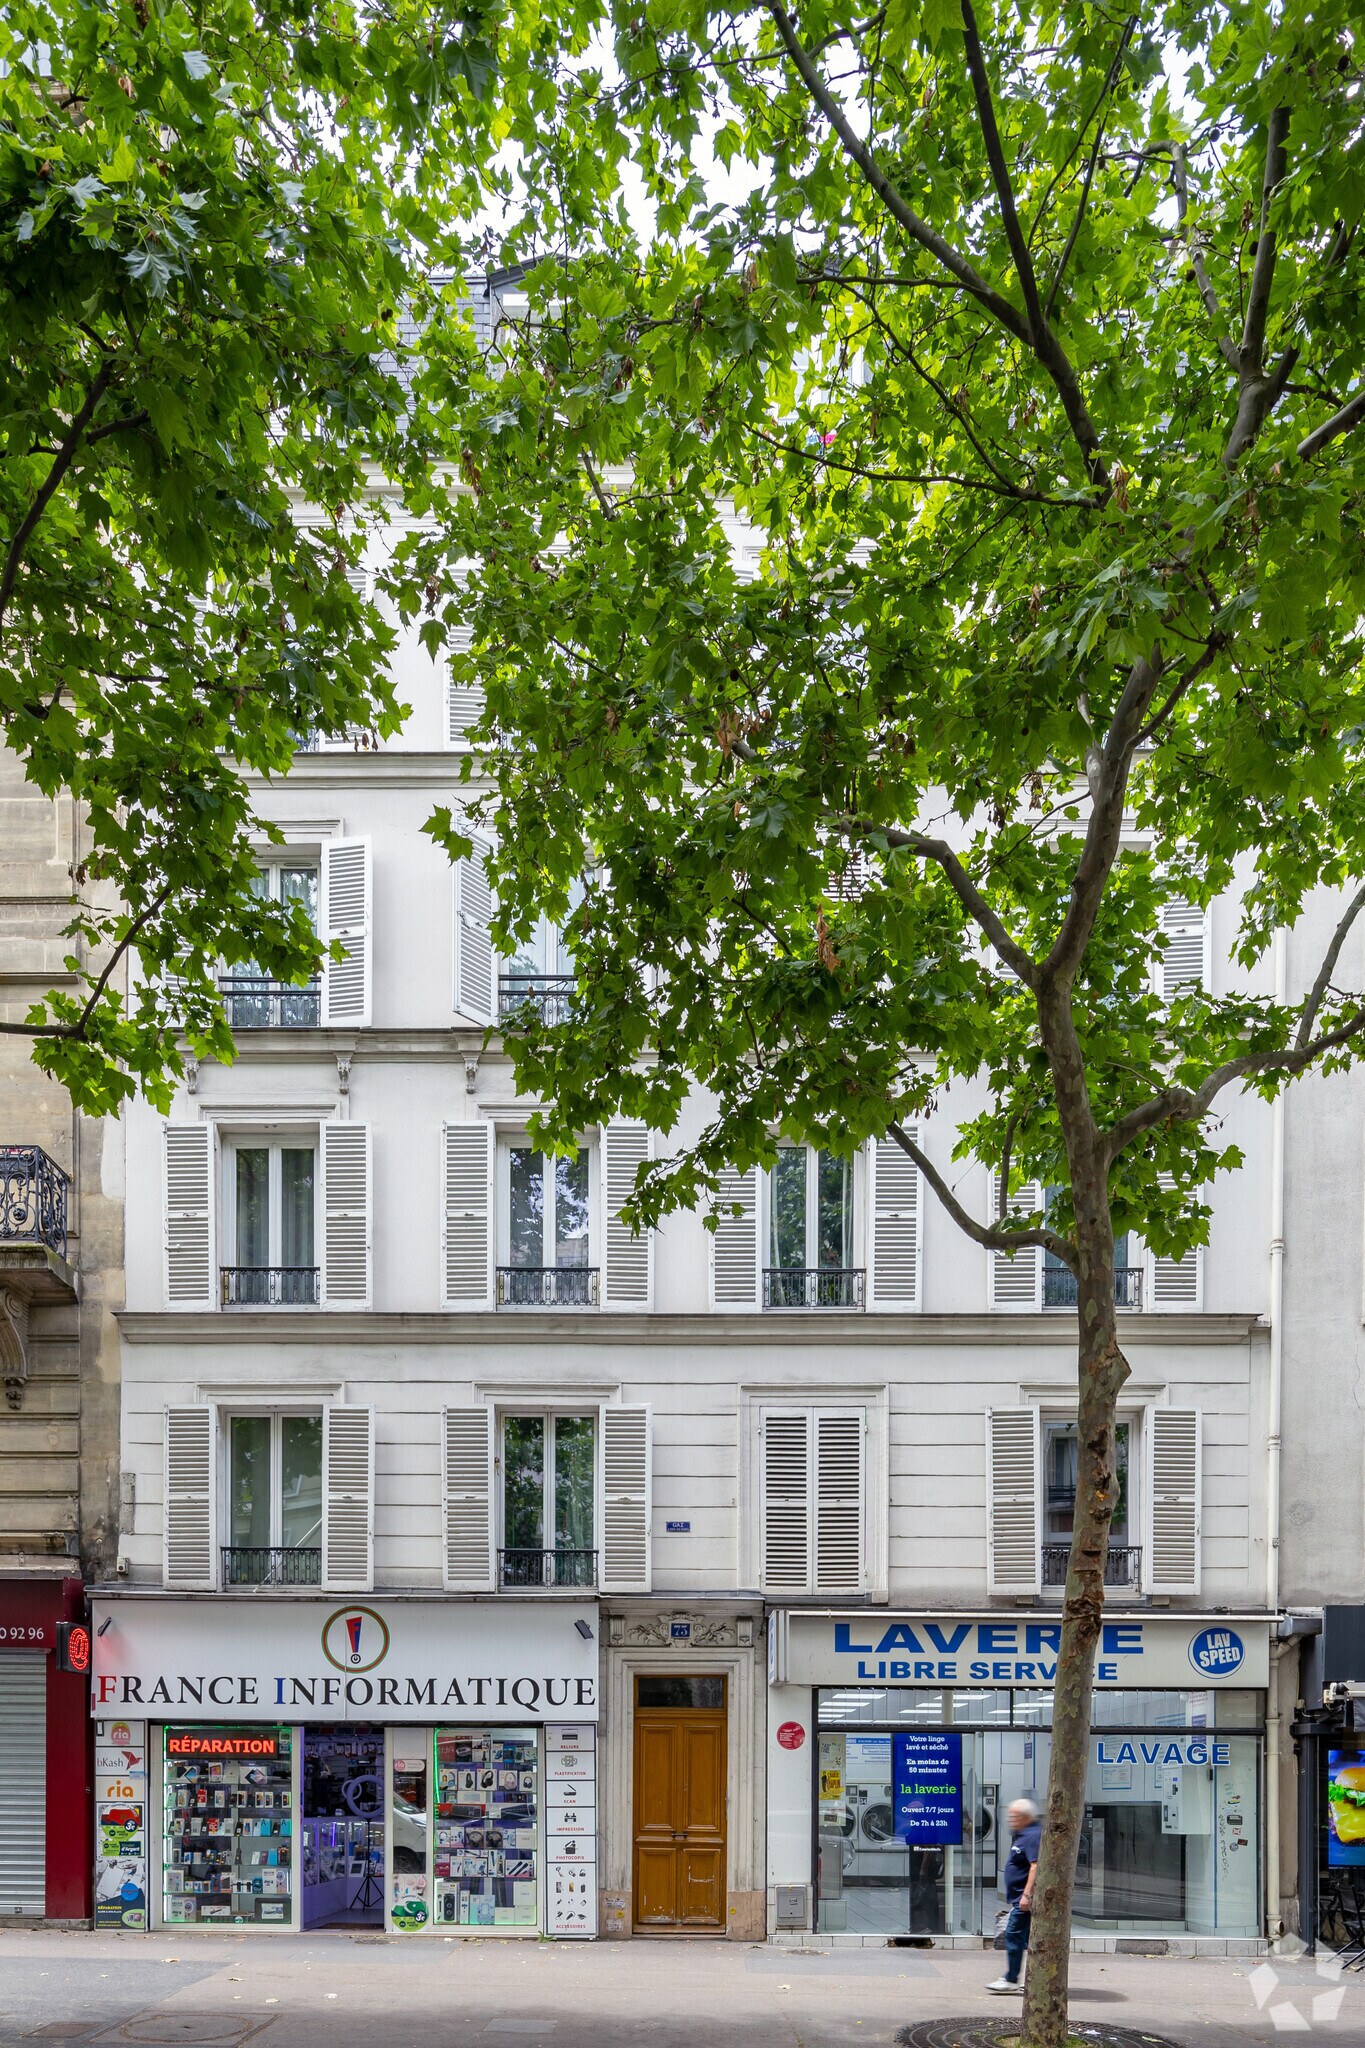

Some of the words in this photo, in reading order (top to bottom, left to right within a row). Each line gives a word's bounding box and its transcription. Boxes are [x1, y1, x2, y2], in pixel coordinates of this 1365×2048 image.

[10, 1627, 25, 1640] 92
[28, 1627, 44, 1640] 96
[674, 1625, 688, 1636] 73
[835, 1624, 1143, 1654] LAVERE
[1206, 1633, 1230, 1650] LAV
[1199, 1647, 1240, 1667] SPEED
[858, 1661, 957, 1679] LIBRE
[969, 1661, 1118, 1680] SERVE
[97, 1676, 259, 1704] FRANCE
[274, 1677, 596, 1712] INFORMATIQUE
[113, 1728, 129, 1739] ria
[169, 1736, 274, 1753] RÉPARATION
[97, 1757, 124, 1767] bKash
[1097, 1742, 1230, 1765] LAVAGE
[107, 1780, 134, 1798] ria
[901, 1784, 912, 1794] la
[914, 1784, 956, 1794] laverie
[937, 1806, 954, 1814] jours
